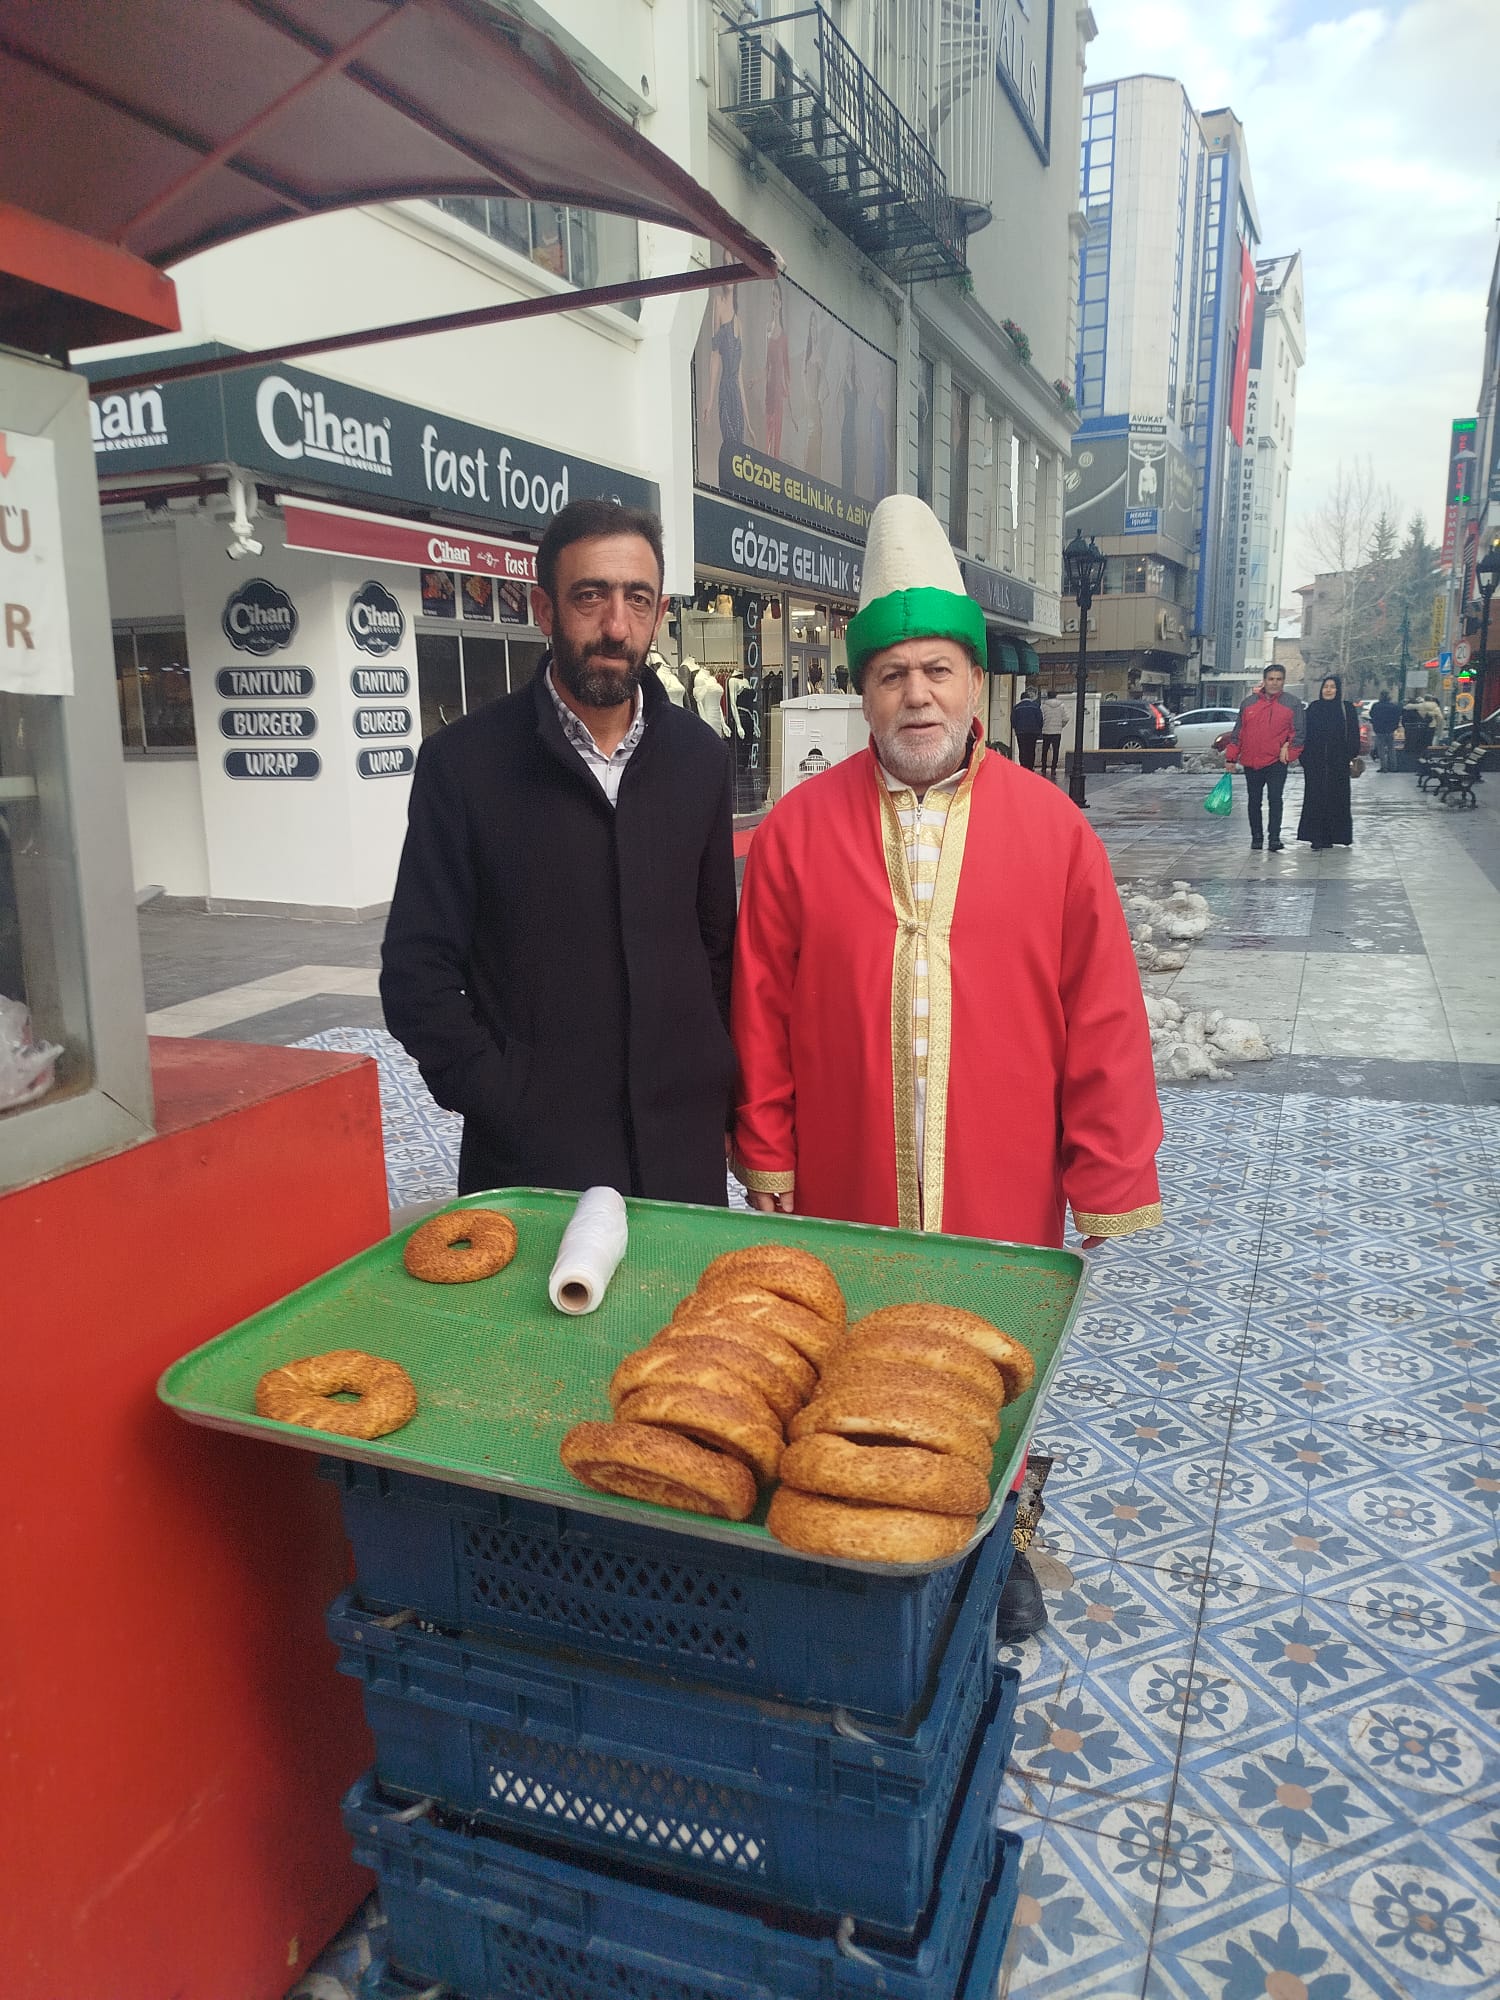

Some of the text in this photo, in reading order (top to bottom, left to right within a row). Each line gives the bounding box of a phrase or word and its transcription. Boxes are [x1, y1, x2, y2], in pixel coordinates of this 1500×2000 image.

[257, 376, 391, 466] Cihan
[1132, 415, 1163, 424] AVUKAT
[421, 424, 569, 515] fast food
[732, 454, 781, 494] GÖZDE
[784, 478, 834, 516] GELİNLİK
[836, 500, 844, 519] &
[427, 538, 469, 564] Cihan
[504, 552, 529, 576] fast
[731, 521, 860, 593] GÖZDE GELİNLİK &
[4, 603, 35, 650] R
[230, 602, 290, 634] Cihan
[352, 602, 400, 635] Cihan
[233, 712, 303, 736] BURGER
[360, 712, 406, 733] BURGER
[245, 753, 298, 776] WRAP
[368, 751, 404, 774] WRAP
